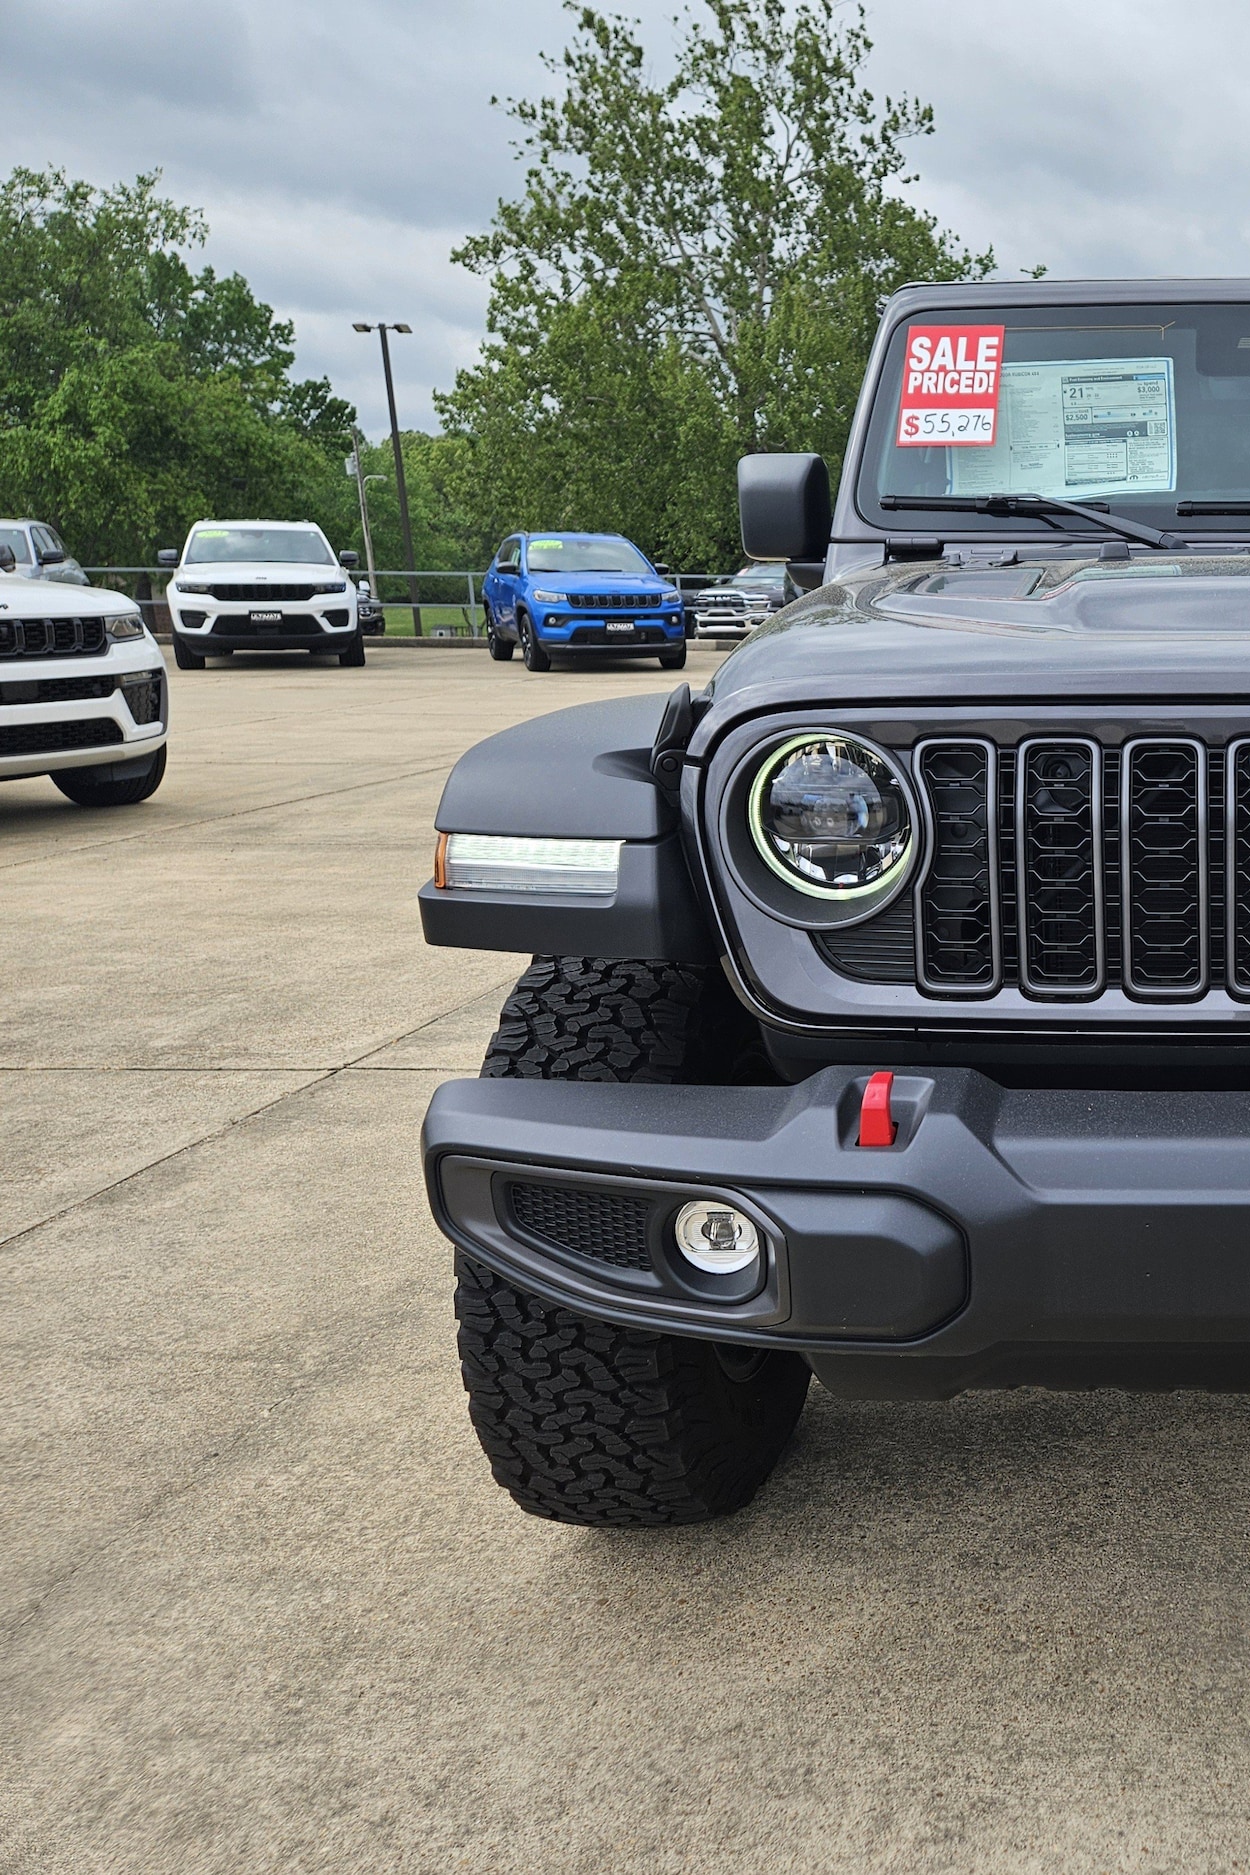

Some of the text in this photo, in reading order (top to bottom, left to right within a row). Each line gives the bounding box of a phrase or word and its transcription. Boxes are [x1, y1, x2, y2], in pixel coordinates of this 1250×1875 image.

[908, 336, 999, 371] SALE
[907, 371, 995, 394] PRICED!
[1137, 385, 1160, 394] $3,000
[1069, 387, 1084, 399] 21
[904, 413, 991, 438] $55,276
[250, 612, 281, 620] ULTIMATE
